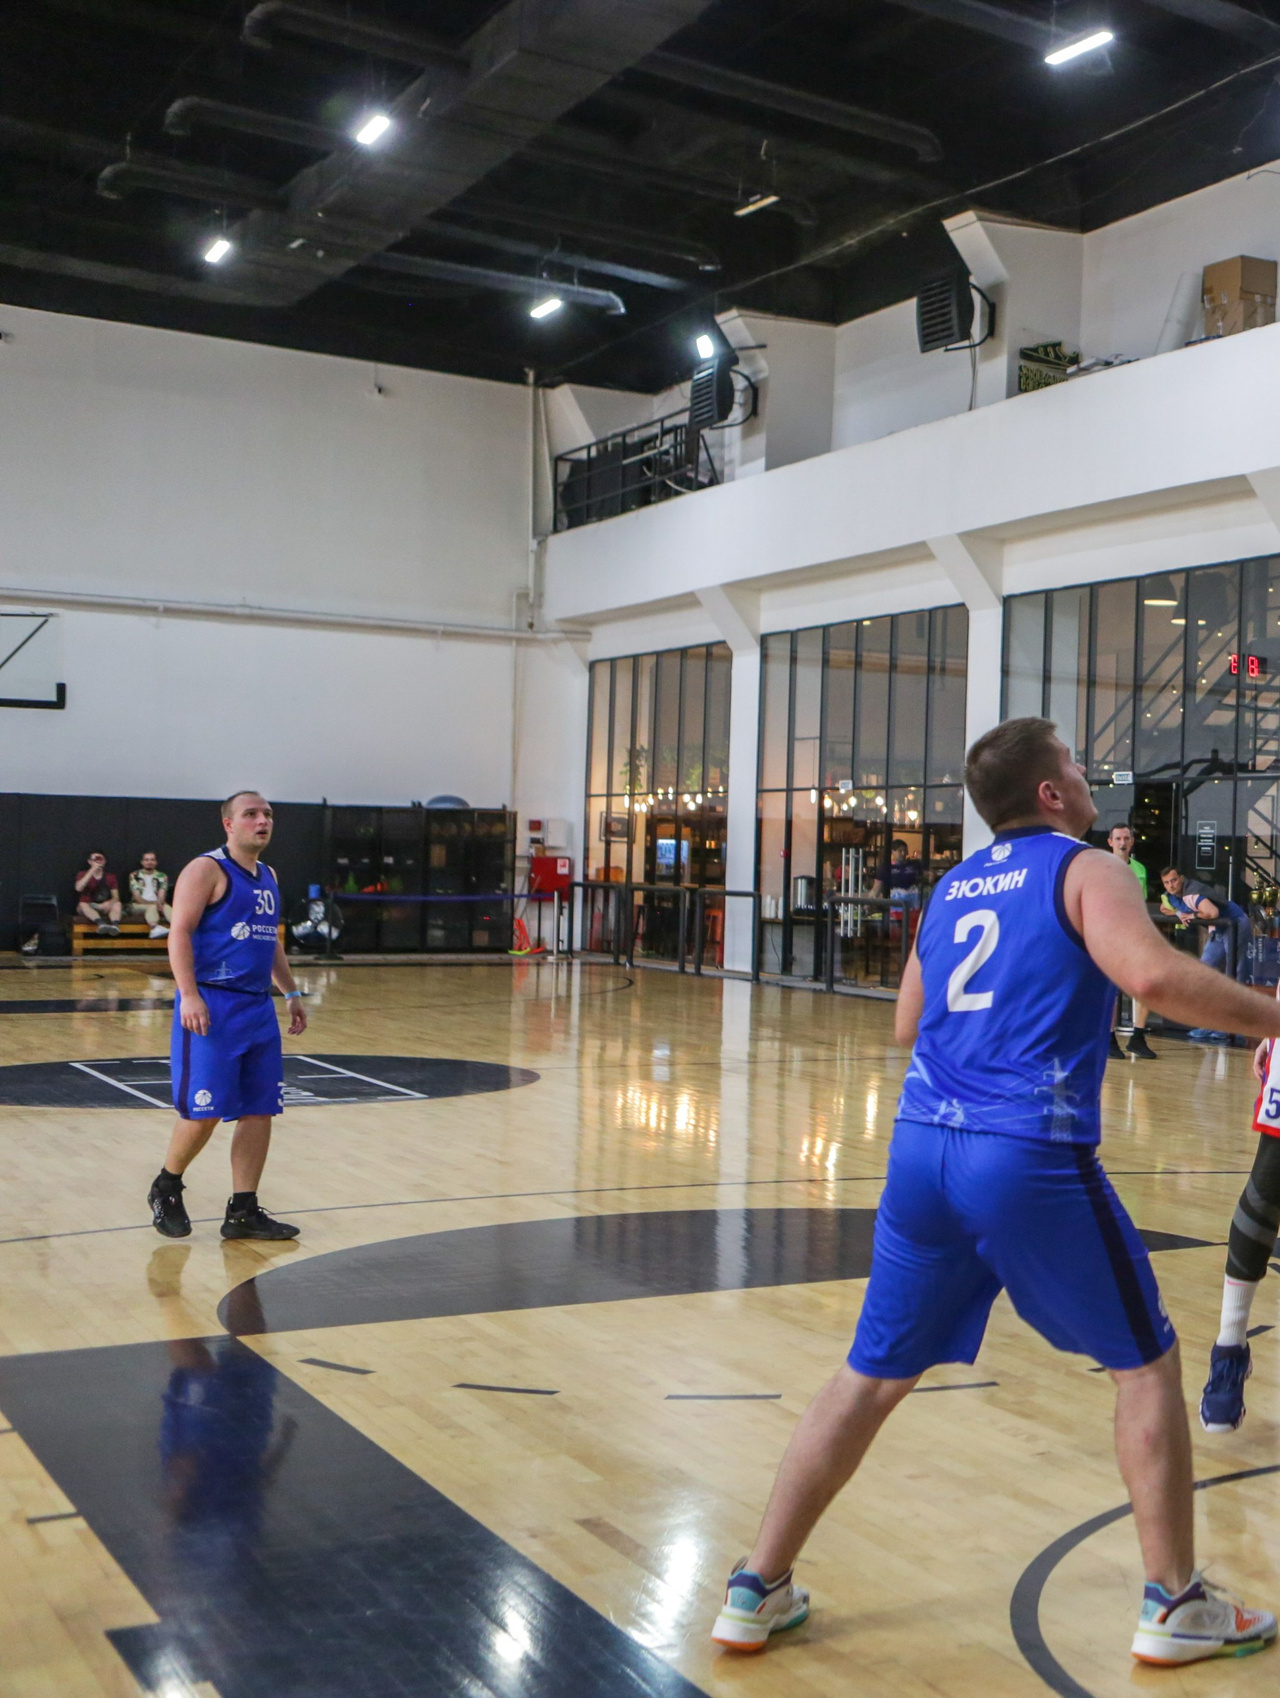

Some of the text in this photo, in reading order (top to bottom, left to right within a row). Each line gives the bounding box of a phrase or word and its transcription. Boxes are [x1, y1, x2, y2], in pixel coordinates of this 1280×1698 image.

[945, 868, 1028, 901] ЗЮКИН
[253, 889, 275, 915] 30
[946, 909, 1000, 1012] 2
